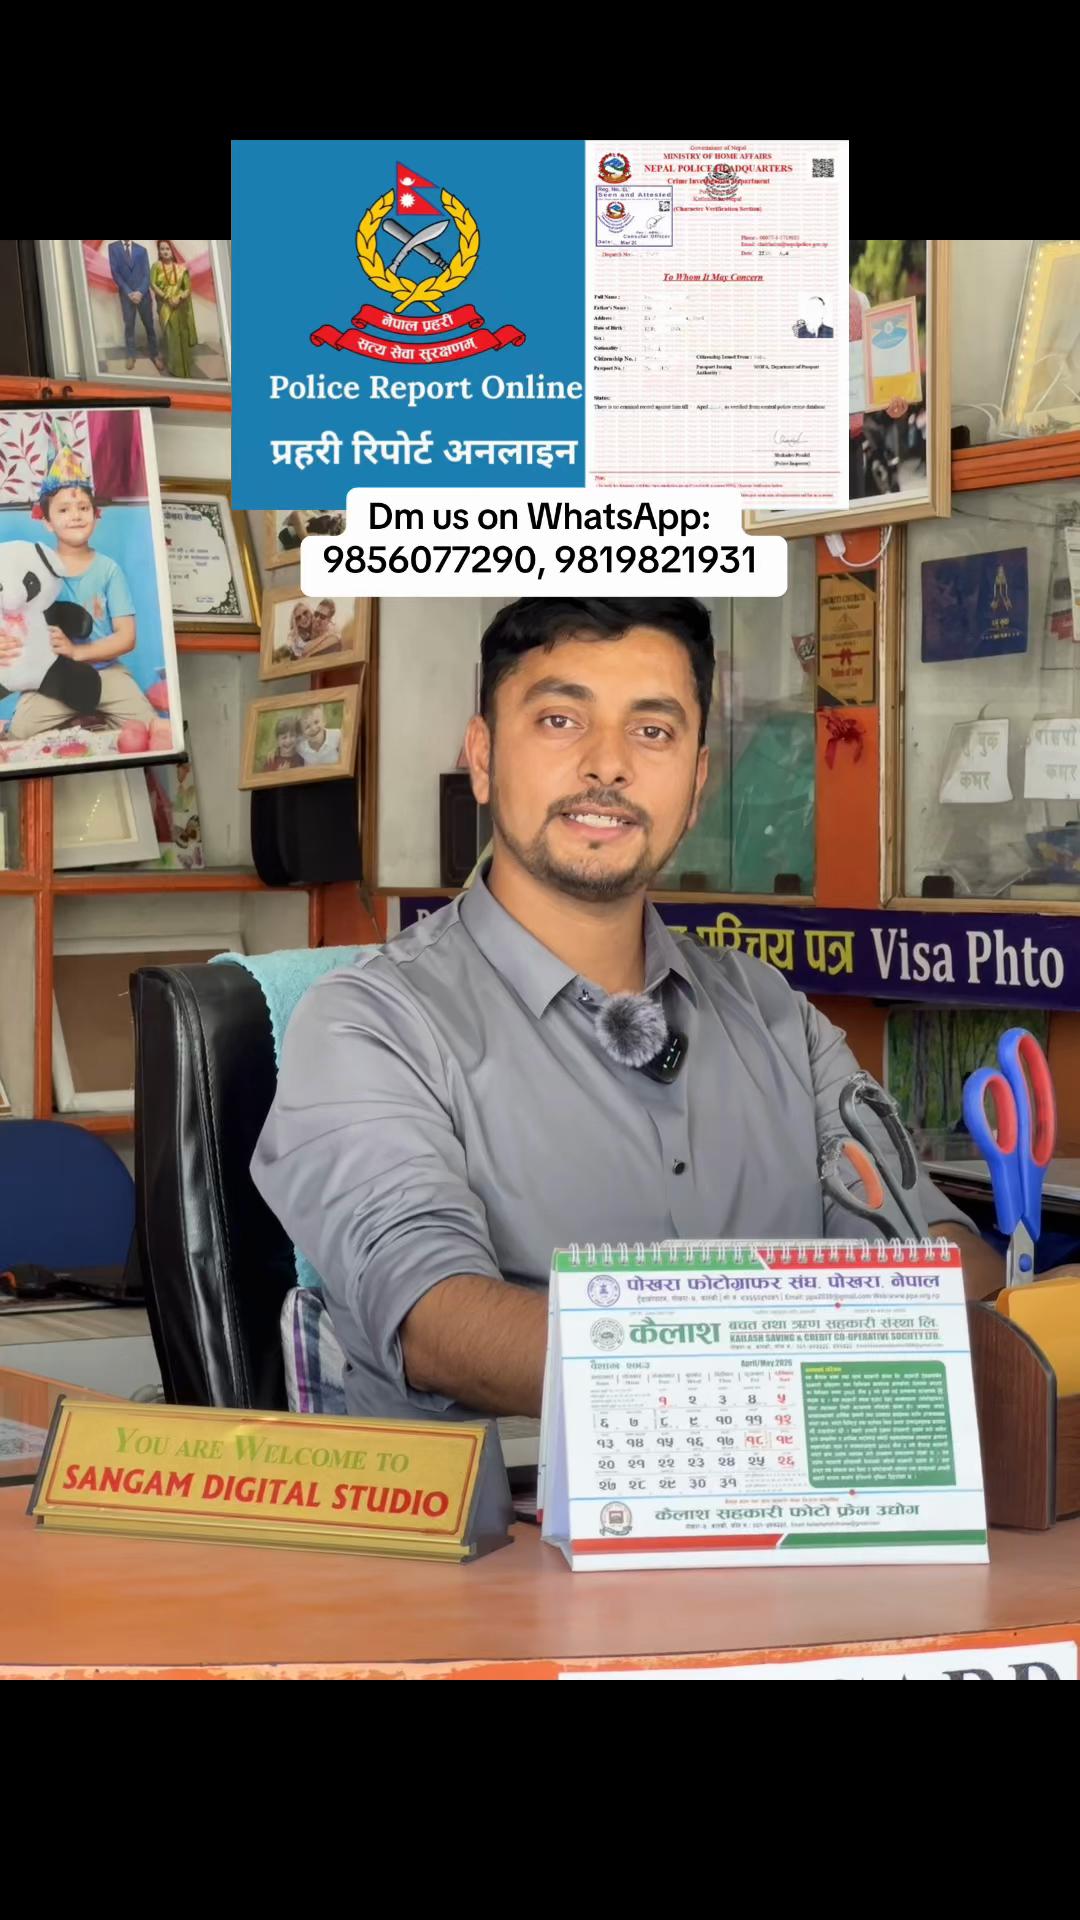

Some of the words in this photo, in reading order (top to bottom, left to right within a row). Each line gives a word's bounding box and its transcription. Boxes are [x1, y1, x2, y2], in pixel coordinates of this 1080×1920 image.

[804, 930, 855, 975] पत्र
[870, 927, 954, 983] Visa
[966, 931, 1065, 990] Phto
[627, 1275, 680, 1291] पोखरा
[688, 1274, 782, 1291] फोटोग्राफर
[891, 1271, 940, 1288] नेपाल
[729, 1320, 757, 1330] बचत
[762, 1320, 787, 1330] तथा
[826, 1316, 875, 1330] सहकारी
[881, 1317, 914, 1329] संस्था
[629, 1316, 722, 1345] कैलाश
[765, 1334, 795, 1342] SAVING
[804, 1333, 832, 1341] CREDIT
[891, 1332, 923, 1340] SOCIETY
[741, 1360, 775, 1369] April/May
[688, 1395, 697, 1405] २
[719, 1395, 727, 1405] ३
[629, 1418, 639, 1427] ७
[716, 1415, 733, 1425] १०
[745, 1415, 762, 1425] ११
[774, 1414, 792, 1425] १२
[596, 1439, 614, 1449] १३
[626, 1438, 644, 1448] १४
[686, 1437, 704, 1447] १६
[716, 1436, 734, 1446] १७
[175, 1438, 224, 1460] ARE
[234, 1433, 369, 1471] WELCOME
[375, 1452, 410, 1473] TO
[598, 1459, 615, 1469] २०
[628, 1459, 645, 1468] २१
[658, 1458, 675, 1468] २२
[687, 1457, 705, 1468] २३
[718, 1457, 735, 1467] २४
[777, 1456, 795, 1466] २६
[63, 1463, 194, 1498] SANGAM
[201, 1473, 321, 1508] DIGITAL
[331, 1483, 450, 1518] STUDIO
[599, 1480, 616, 1490] २७
[689, 1479, 706, 1488] ३०
[719, 1478, 737, 1488] ३१
[716, 1504, 783, 1519] सहकारी
[789, 1504, 830, 1517] फोटो
[837, 1503, 870, 1517] फ्रेम
[876, 1502, 920, 1516] उद्योग
